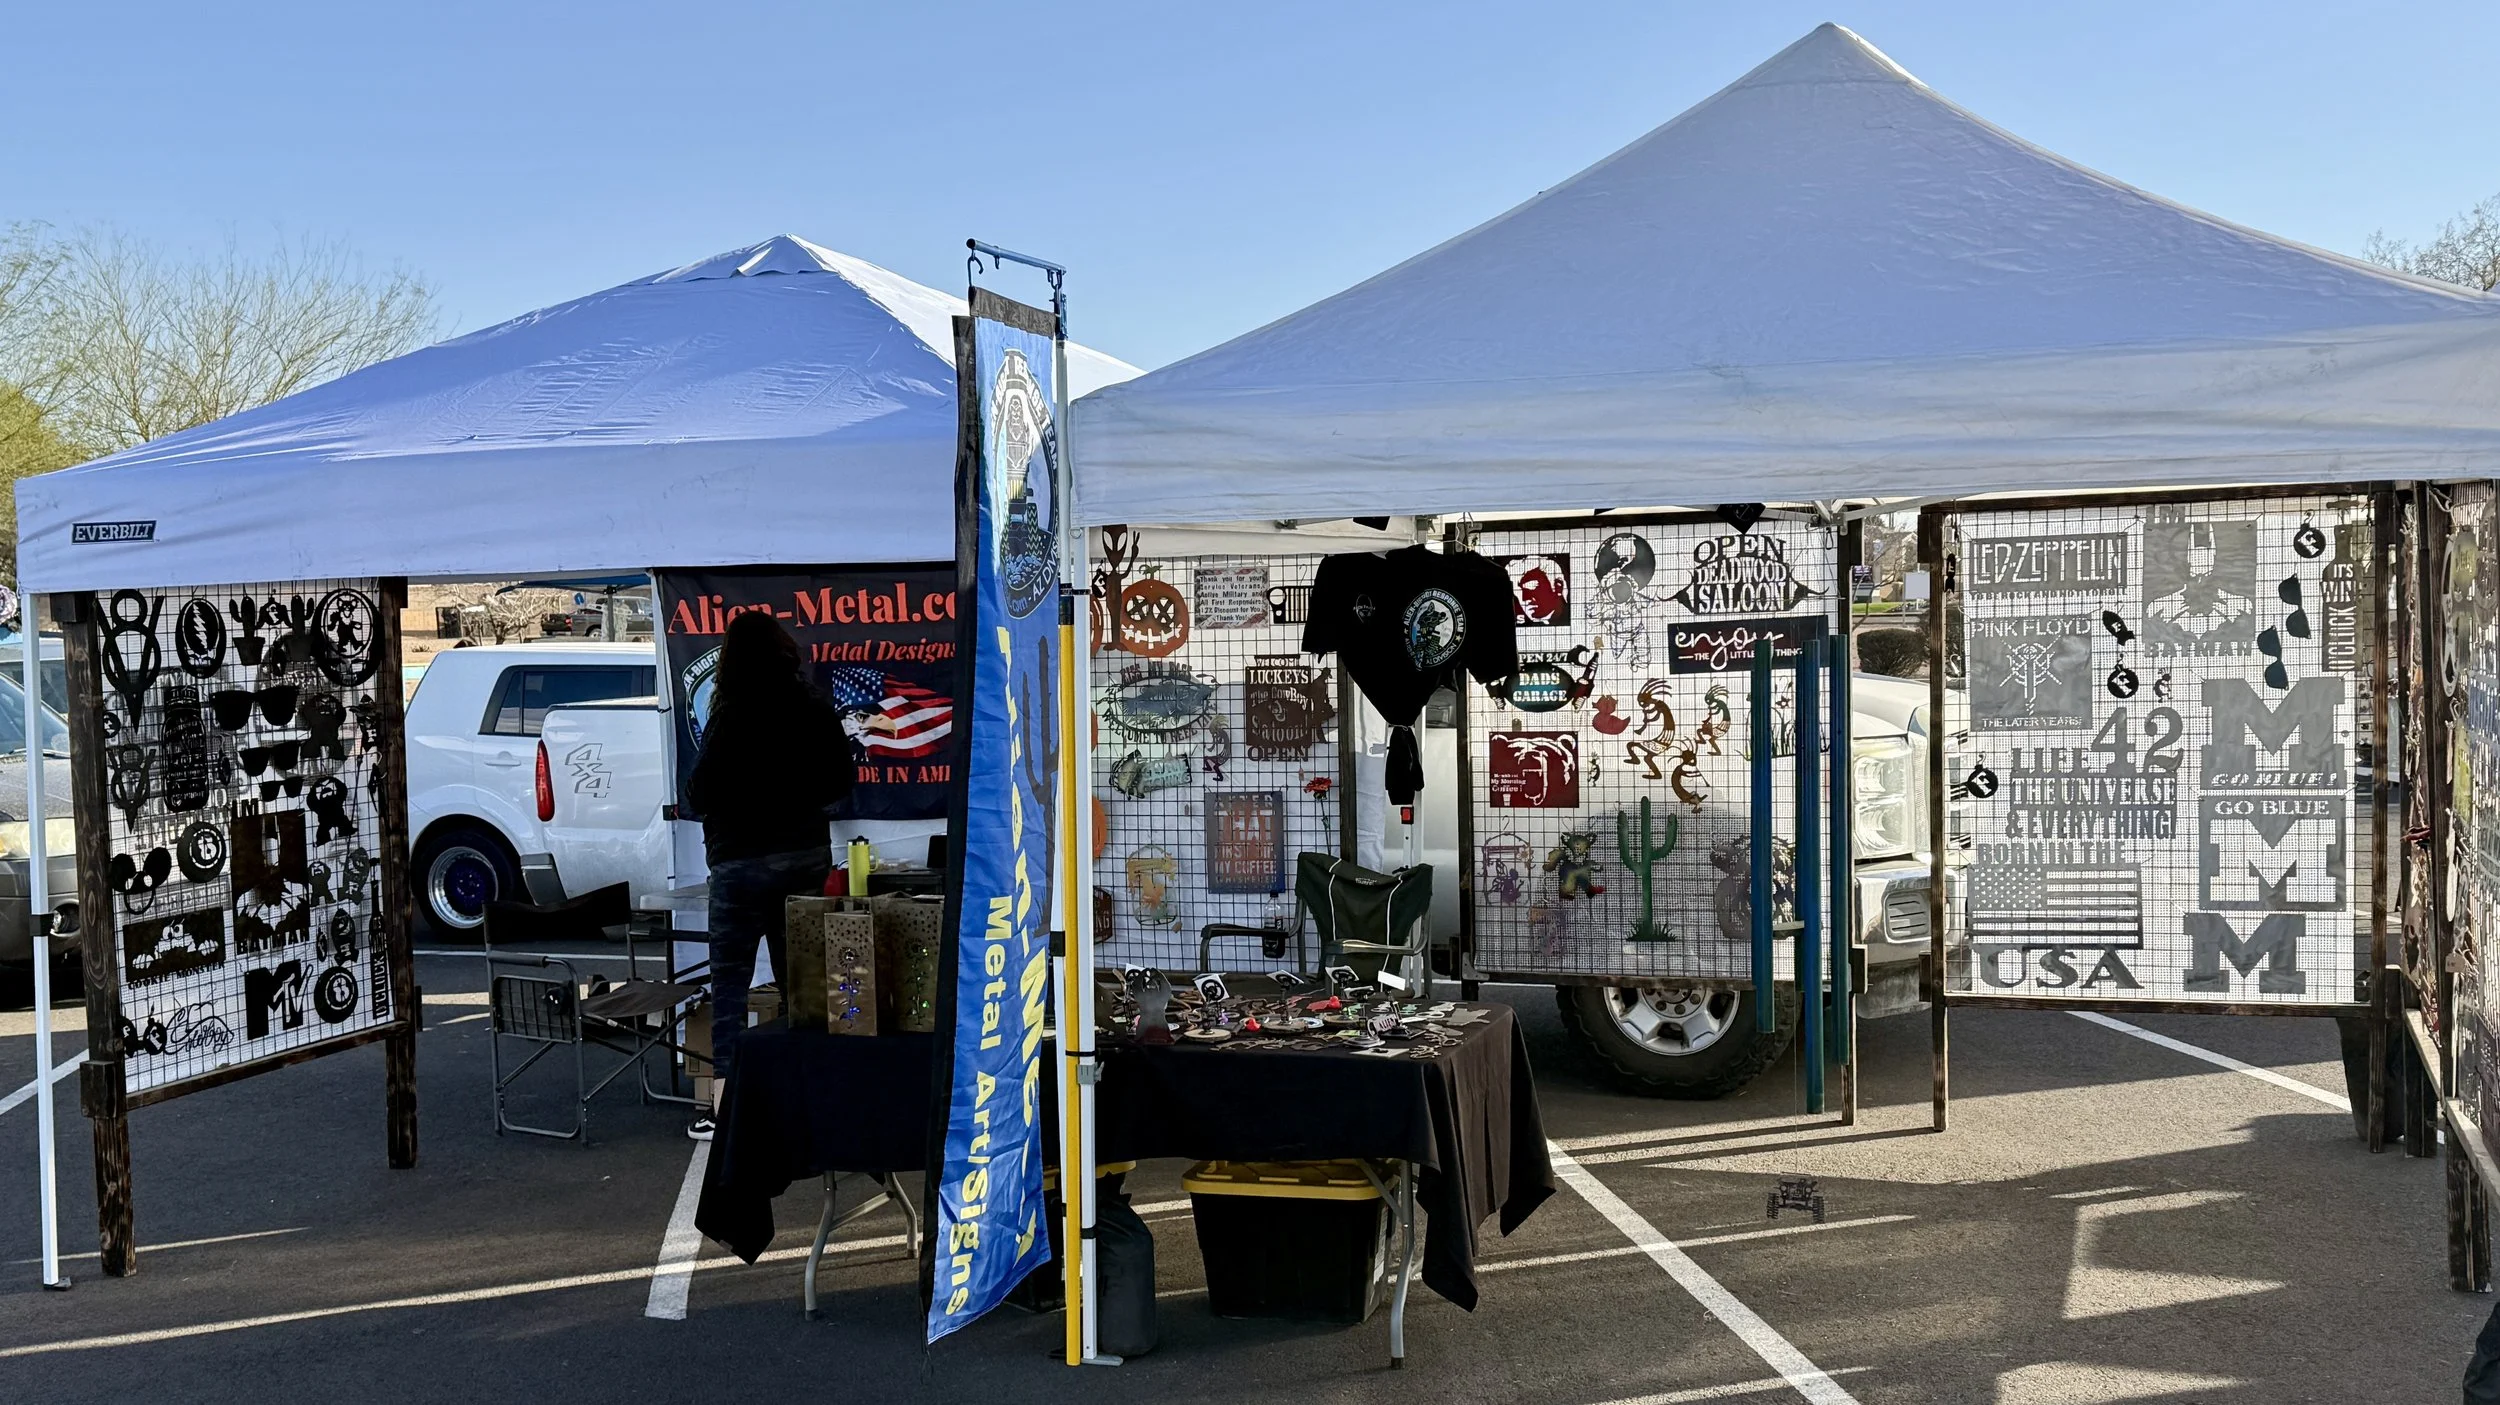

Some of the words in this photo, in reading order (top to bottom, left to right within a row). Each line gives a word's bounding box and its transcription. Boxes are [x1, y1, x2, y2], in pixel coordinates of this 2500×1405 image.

[75, 522, 153, 541] EVERBILT
[1694, 534, 1786, 567] OPEN
[1696, 557, 1787, 585] DEADWOOD
[2333, 563, 2354, 578] IT'S
[1699, 582, 1786, 614] SALOON
[1971, 620, 2018, 638] PINK
[2023, 617, 2092, 636] FLOYD
[809, 639, 873, 664] Metal
[1518, 653, 1544, 663] PEN
[1546, 653, 1569, 663] 24/7
[1694, 652, 1710, 661] THE
[1249, 669, 1309, 684] LUCKEYS
[1512, 690, 1568, 702] GARAGE
[1982, 718, 2003, 729] THE
[2005, 717, 2039, 728] LATER
[2091, 706, 2185, 774] 42
[1247, 745, 1309, 762] OPEN
[2011, 747, 2090, 774] LIFE
[886, 766, 909, 783] IN
[2012, 777, 2056, 805] THE
[2061, 777, 2176, 805] UNIVERSE
[2214, 800, 2255, 816] GO
[2261, 799, 2330, 816] BLUE
[1214, 809, 1275, 842] THAT
[2005, 811, 2024, 839] &
[1978, 843, 2044, 866] BORN
[2079, 841, 2126, 864] THE
[177, 961, 225, 980] MONSTER
[979, 895, 1013, 1051] Metal
[1973, 944, 2145, 989] USA
[945, 1071, 996, 1317] Art/Signs
